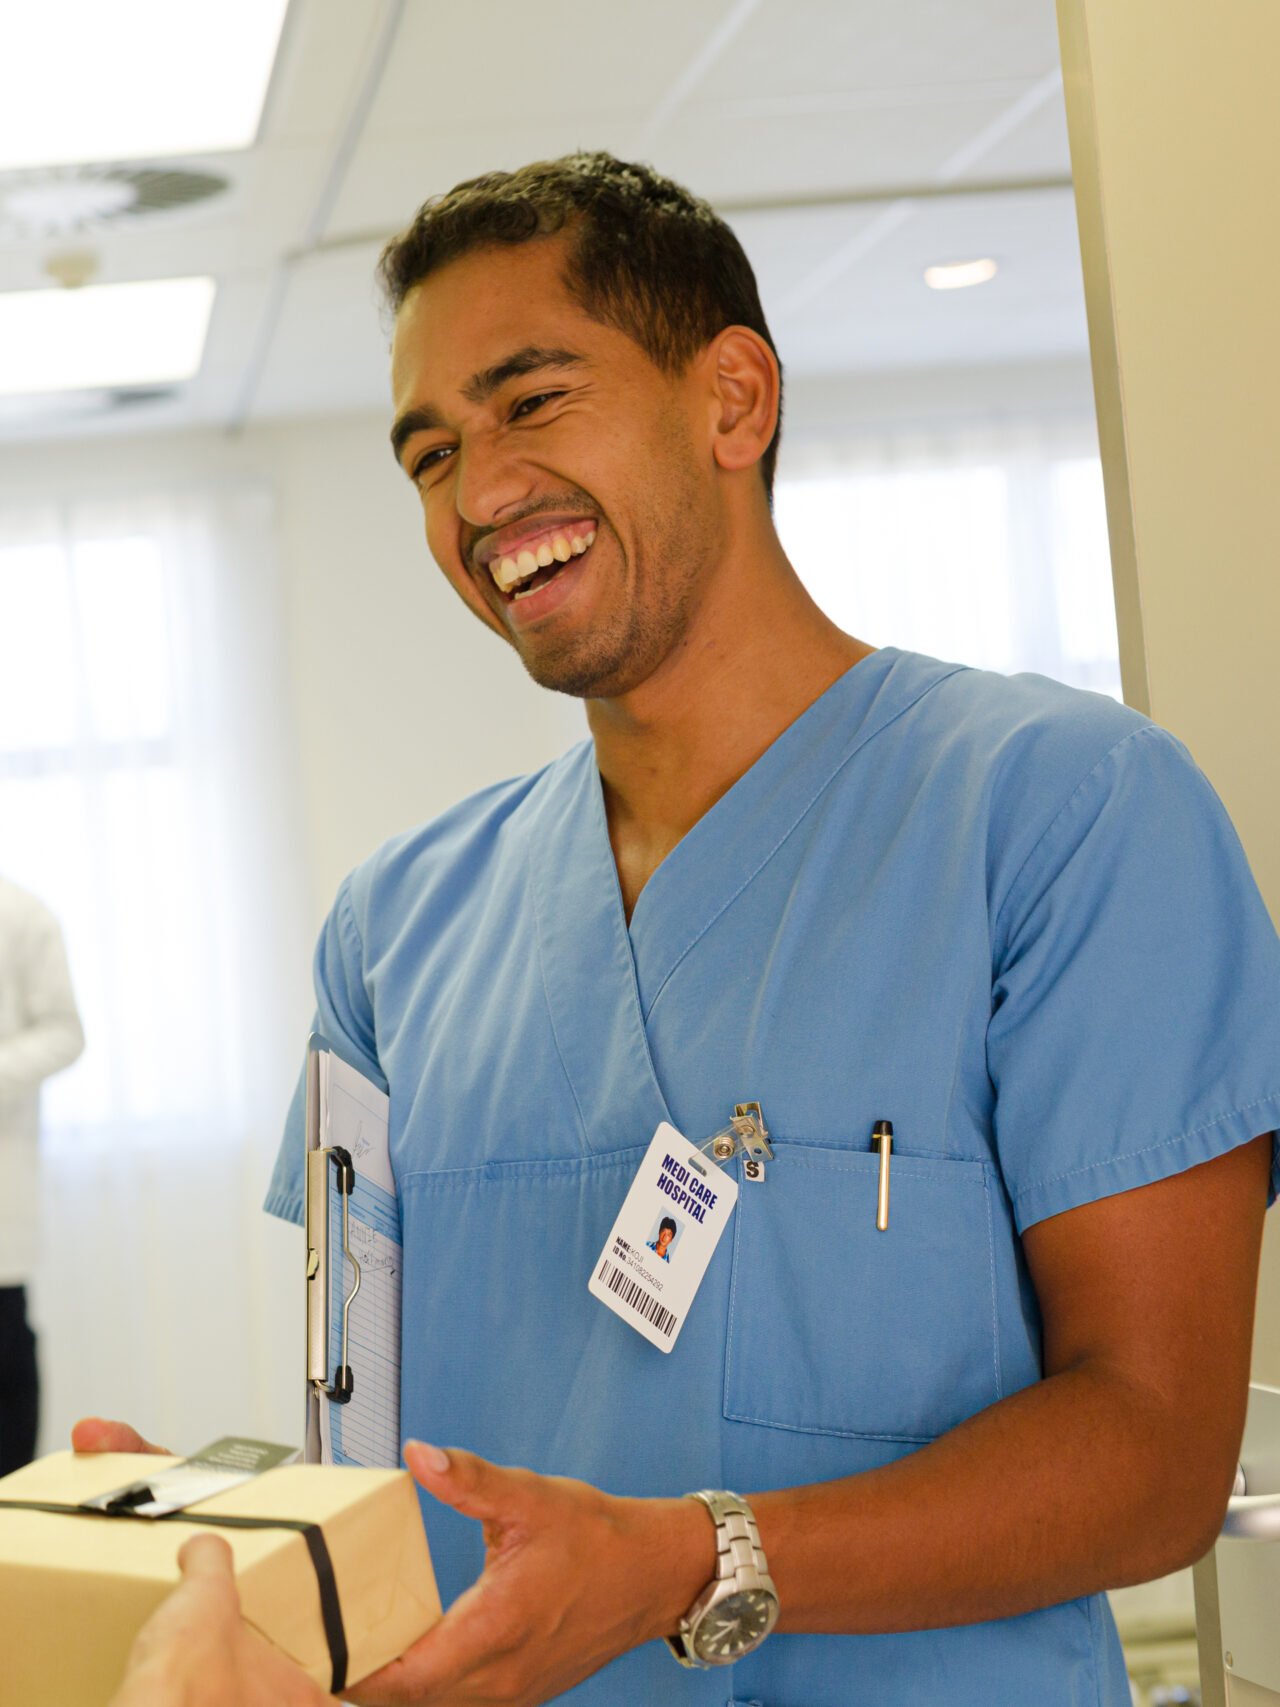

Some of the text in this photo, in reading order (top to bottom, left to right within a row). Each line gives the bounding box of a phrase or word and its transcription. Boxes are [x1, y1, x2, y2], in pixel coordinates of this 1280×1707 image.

[661, 1153, 718, 1210] MEDI CARE
[746, 1161, 760, 1178] S
[656, 1172, 707, 1225] HOSPITAL
